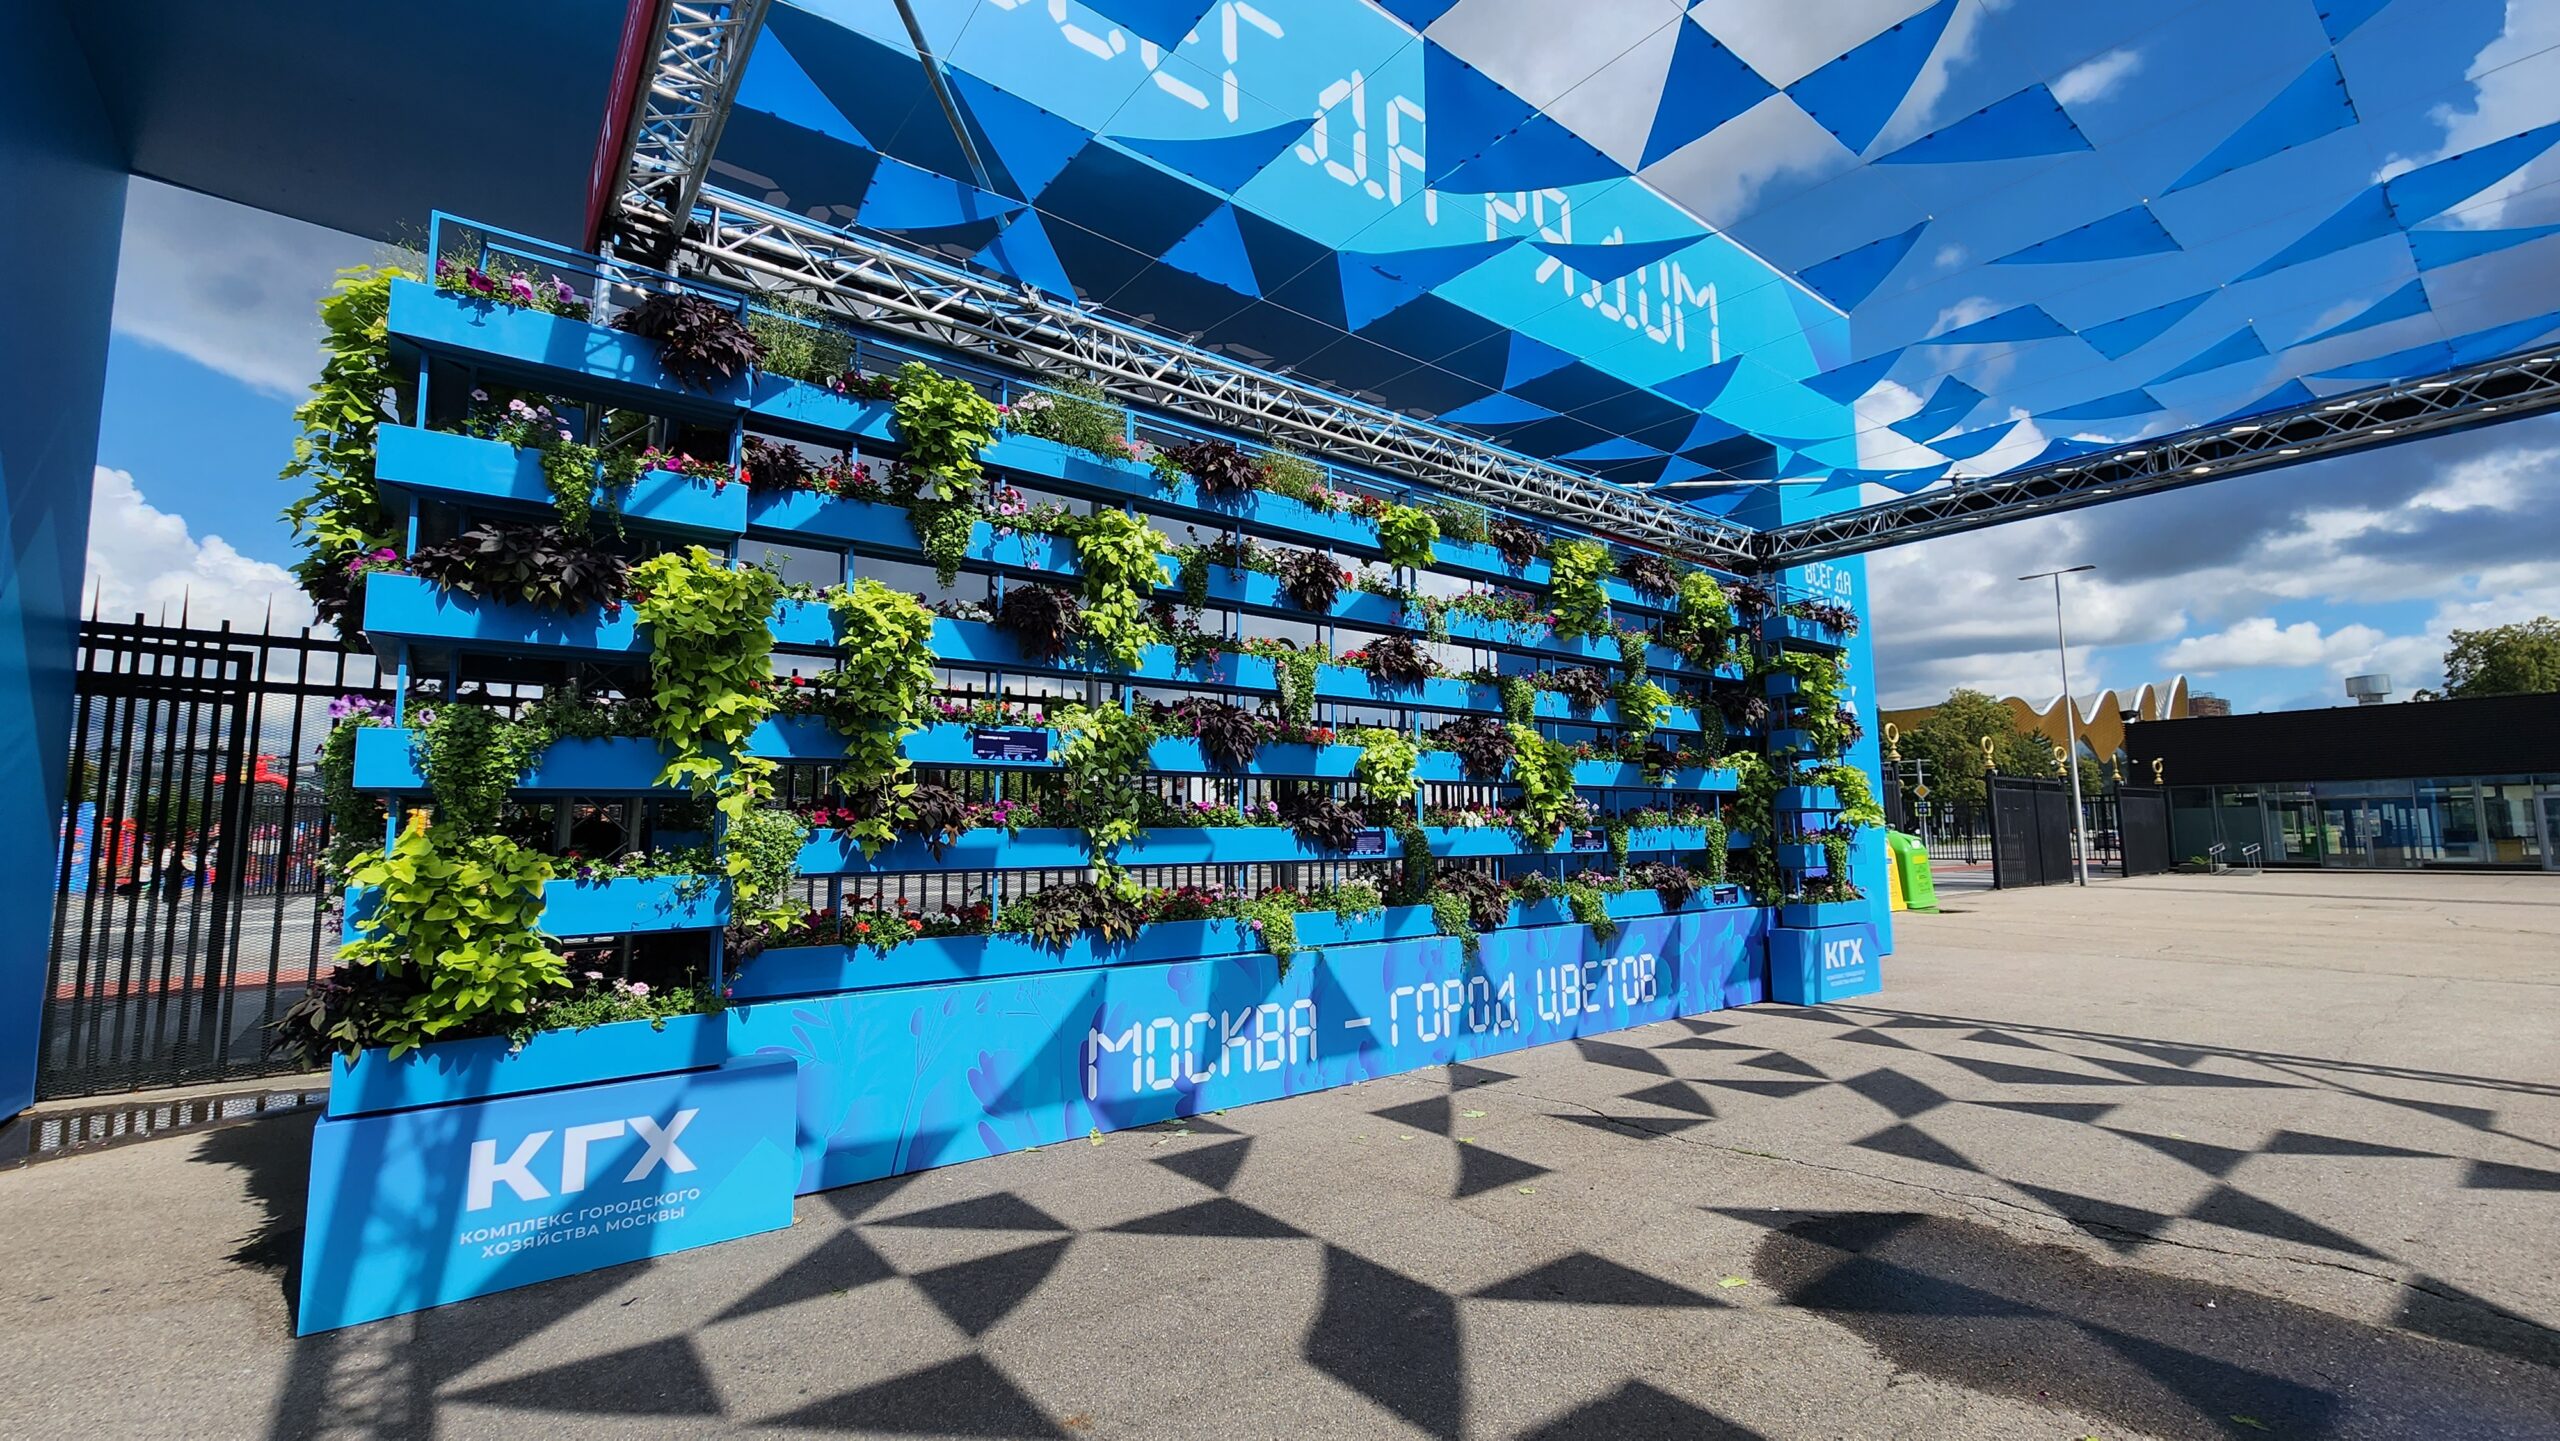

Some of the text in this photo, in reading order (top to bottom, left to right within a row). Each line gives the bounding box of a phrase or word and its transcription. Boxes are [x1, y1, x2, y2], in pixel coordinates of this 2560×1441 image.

[1825, 938, 1864, 969] КГХ
[1088, 998, 1318, 1100] МОСКВА
[1390, 970, 1519, 1048] ГОРОД
[1536, 953, 1658, 1026] ЦВЕТОВ
[467, 1108, 700, 1212] КГХ
[460, 1188, 701, 1245] КОМПЛЕКС ГОРОДСКОГО
[480, 1206, 687, 1259] ХОЗЯЙСТВА МОСКВЫ
